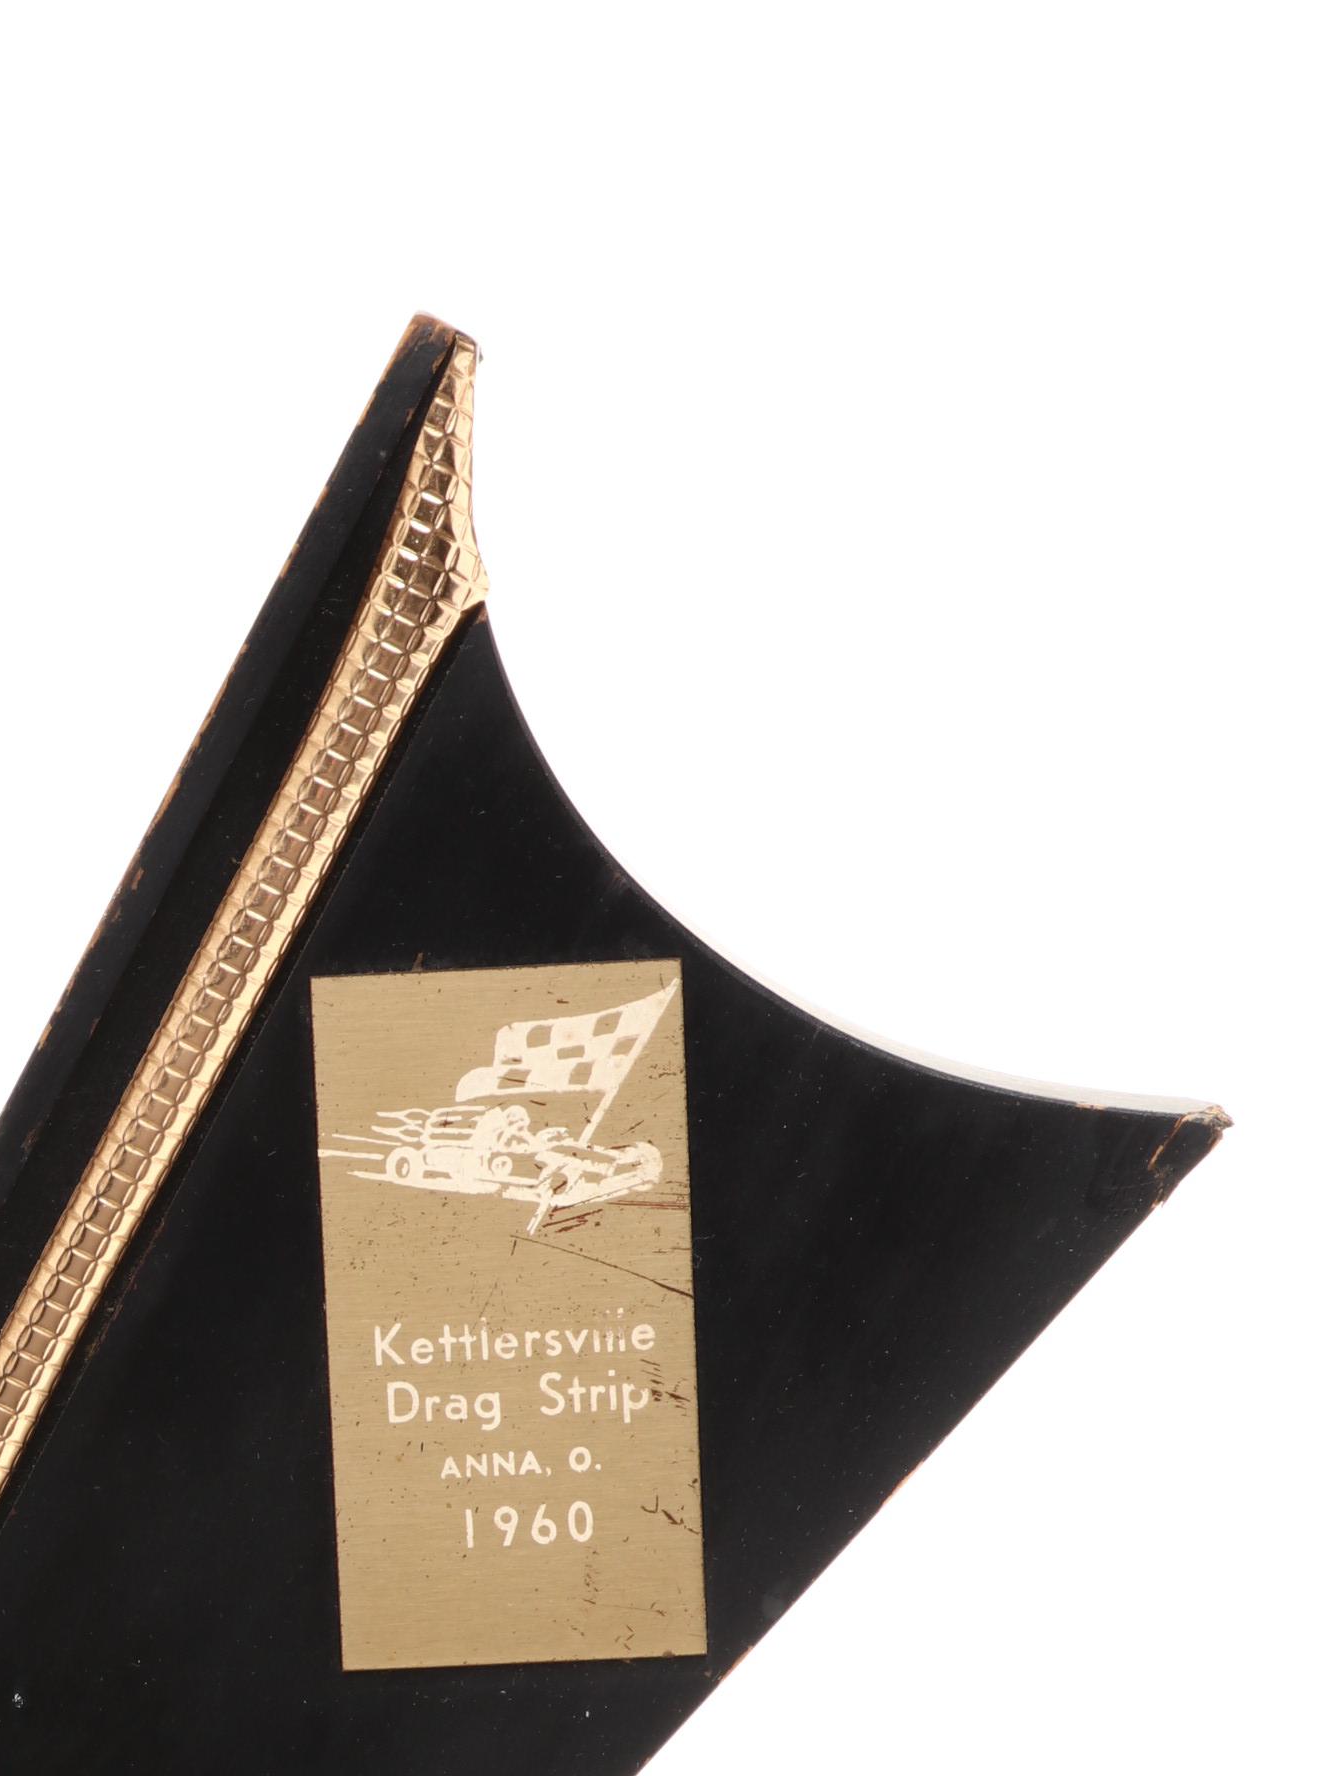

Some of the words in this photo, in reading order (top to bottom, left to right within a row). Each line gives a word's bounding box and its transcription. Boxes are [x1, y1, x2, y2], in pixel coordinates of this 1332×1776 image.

[373, 1308, 656, 1366] Kettlersville
[386, 1380, 501, 1431] Drag
[539, 1370, 650, 1424] Strip
[440, 1451, 552, 1480] ANNA,
[568, 1446, 602, 1473] O.
[464, 1501, 594, 1549] 1960
